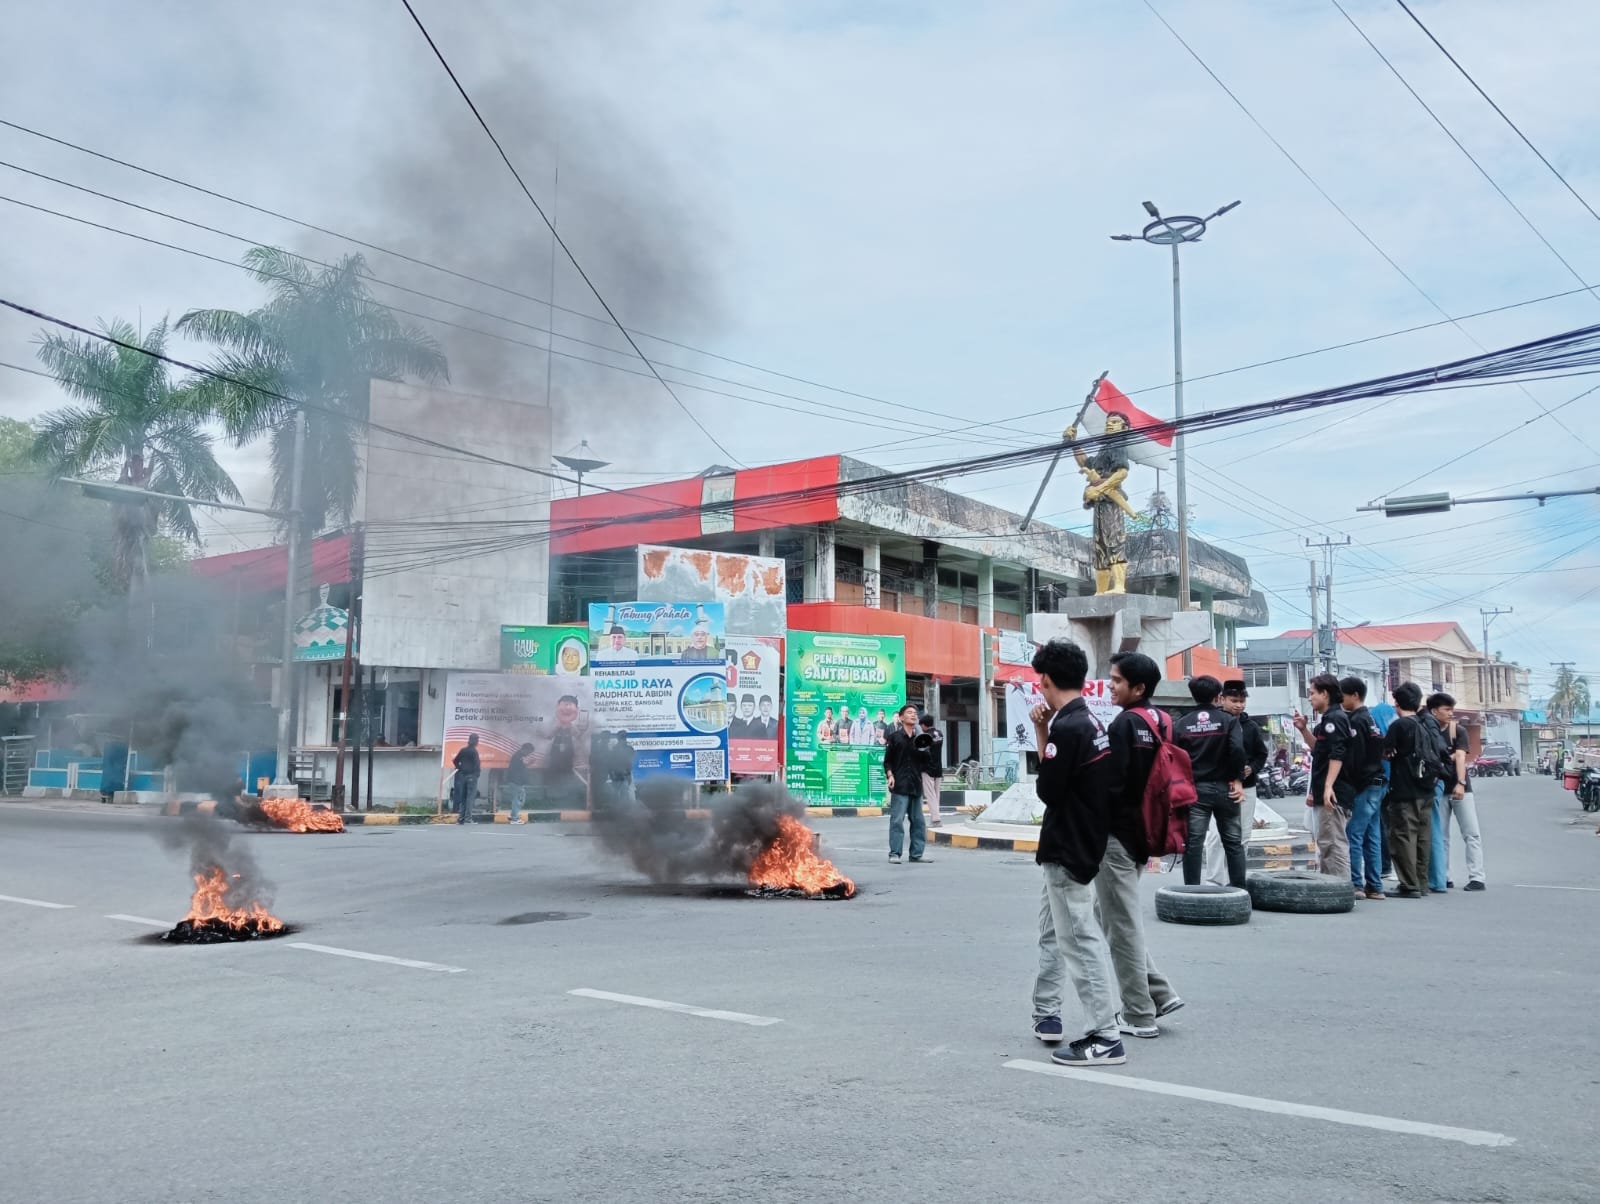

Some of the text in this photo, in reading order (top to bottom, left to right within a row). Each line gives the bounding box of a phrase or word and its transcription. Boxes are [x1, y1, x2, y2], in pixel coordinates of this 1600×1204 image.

[619, 607, 691, 622] Tabung Pahala
[813, 652, 877, 668] PENERIMAAN
[804, 665, 850, 681] SANTRI
[594, 678, 673, 689] MASJID RAYA
[594, 690, 643, 698] RAUDHATUL
[454, 706, 489, 714] Ekonomi
[454, 713, 478, 721] Detak
